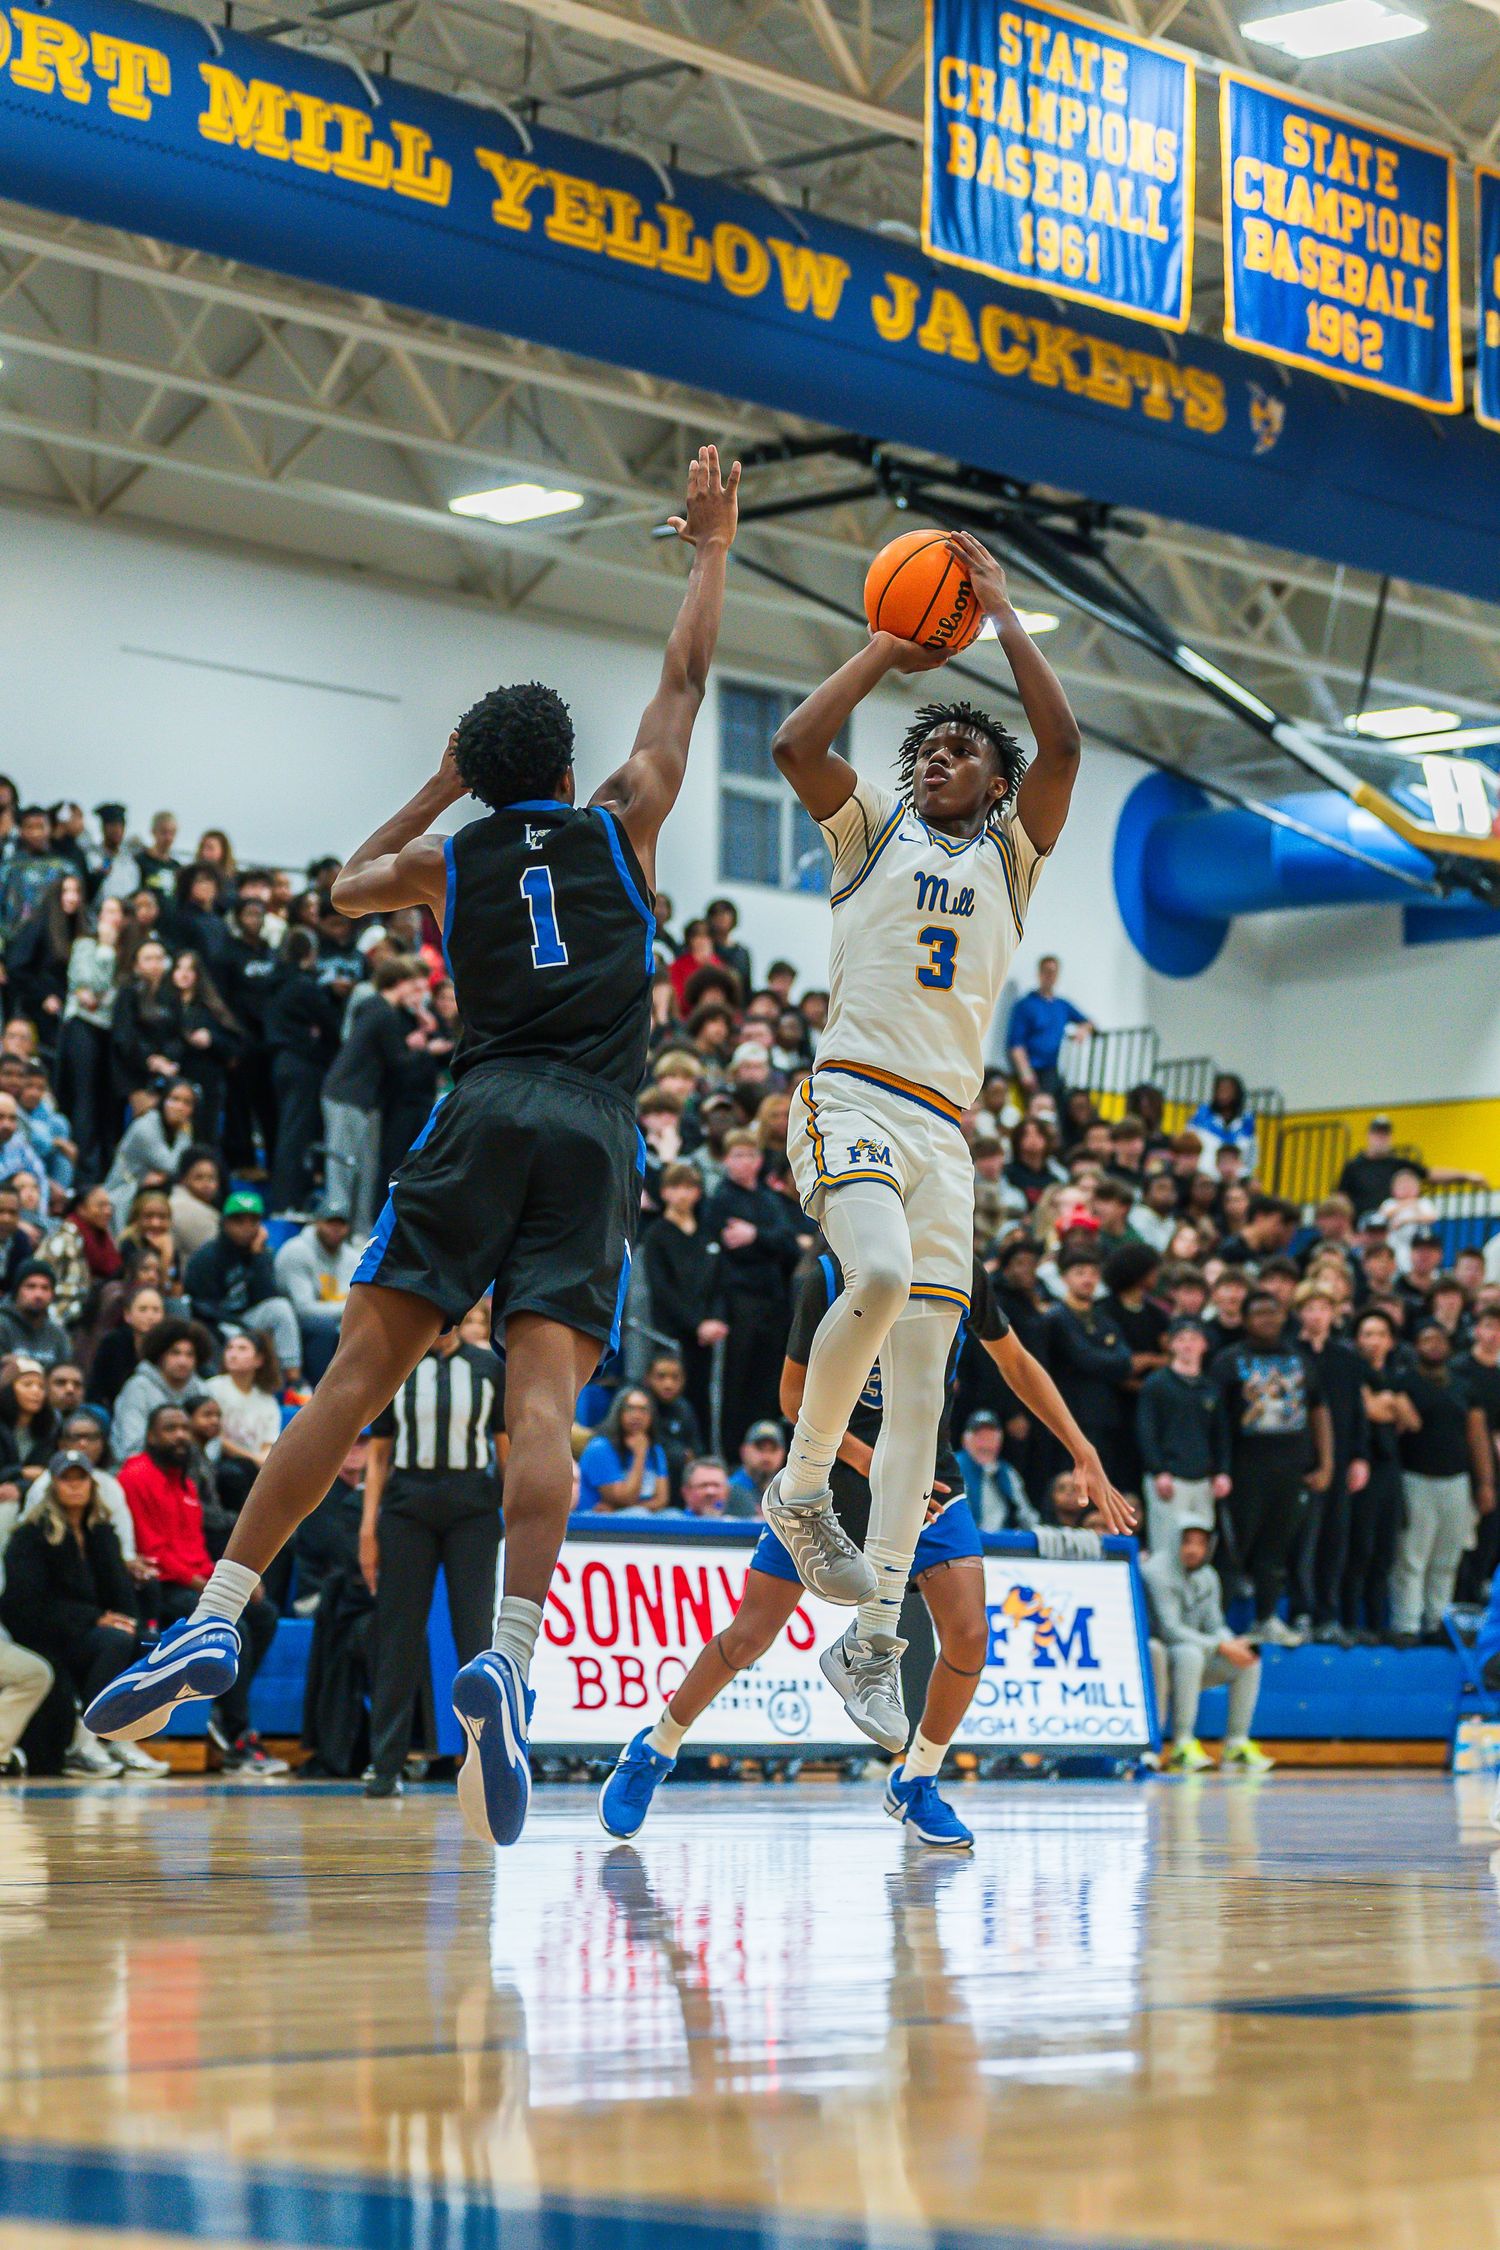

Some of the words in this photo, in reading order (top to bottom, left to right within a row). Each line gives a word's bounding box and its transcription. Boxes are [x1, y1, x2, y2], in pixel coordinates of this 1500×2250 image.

[999, 12, 1128, 105] STATE
[938, 57, 1178, 183] CHAMPIONS
[1282, 114, 1398, 200] STATE
[0, 7, 171, 121] RT
[199, 63, 452, 207] MILL
[475, 148, 851, 320] YELLOW
[871, 272, 1226, 434] JACKETS
[947, 123, 1169, 243] BASEBALL
[1233, 156, 1443, 273] CHAMPIONS
[1017, 212, 1101, 284] 1961
[1242, 217, 1435, 329] BASEBALL
[1306, 301, 1384, 371] 1962
[519, 864, 569, 969] 1
[913, 870, 975, 917] Mill
[915, 923, 961, 992] 3
[544, 1561, 816, 1651] SONNYS
[974, 1678, 1042, 1708] ORT
[1060, 1682, 1136, 1709] MILL
[1027, 1716, 1141, 1738] SCHOOL
